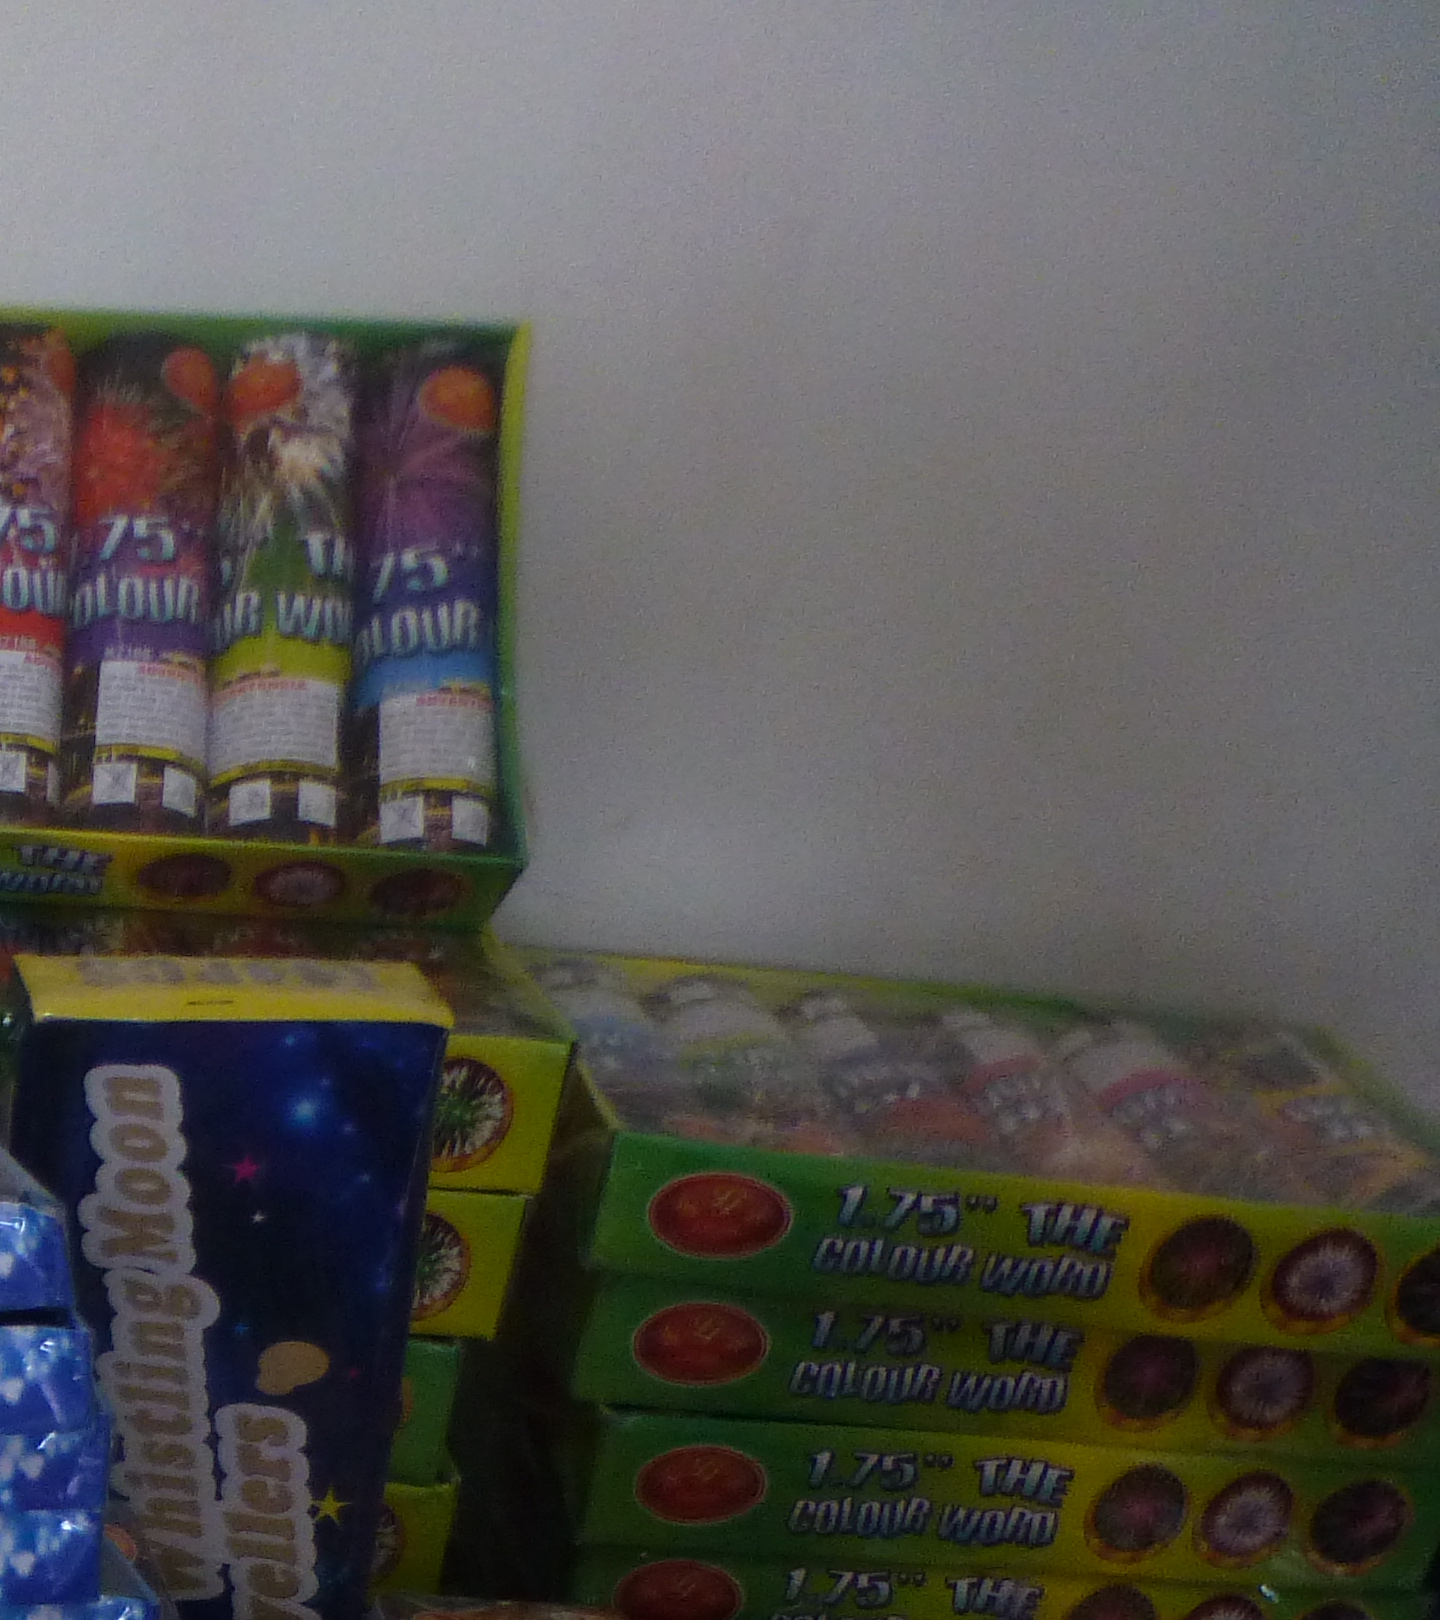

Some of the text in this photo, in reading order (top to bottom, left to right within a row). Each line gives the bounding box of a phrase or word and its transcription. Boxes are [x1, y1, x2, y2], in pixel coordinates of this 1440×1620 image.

[92, 1072, 183, 1266] Moon
[835, 1182, 1131, 1254] 1.75" THE
[810, 1234, 1112, 1300] COLOUR WORD
[984, 1319, 1084, 1370] THE
[788, 1360, 1068, 1416] COLOUR WORD
[107, 1275, 208, 1598] Whistling
[972, 1457, 1074, 1507] THE
[787, 1495, 1059, 1549] COLOUR WORD
